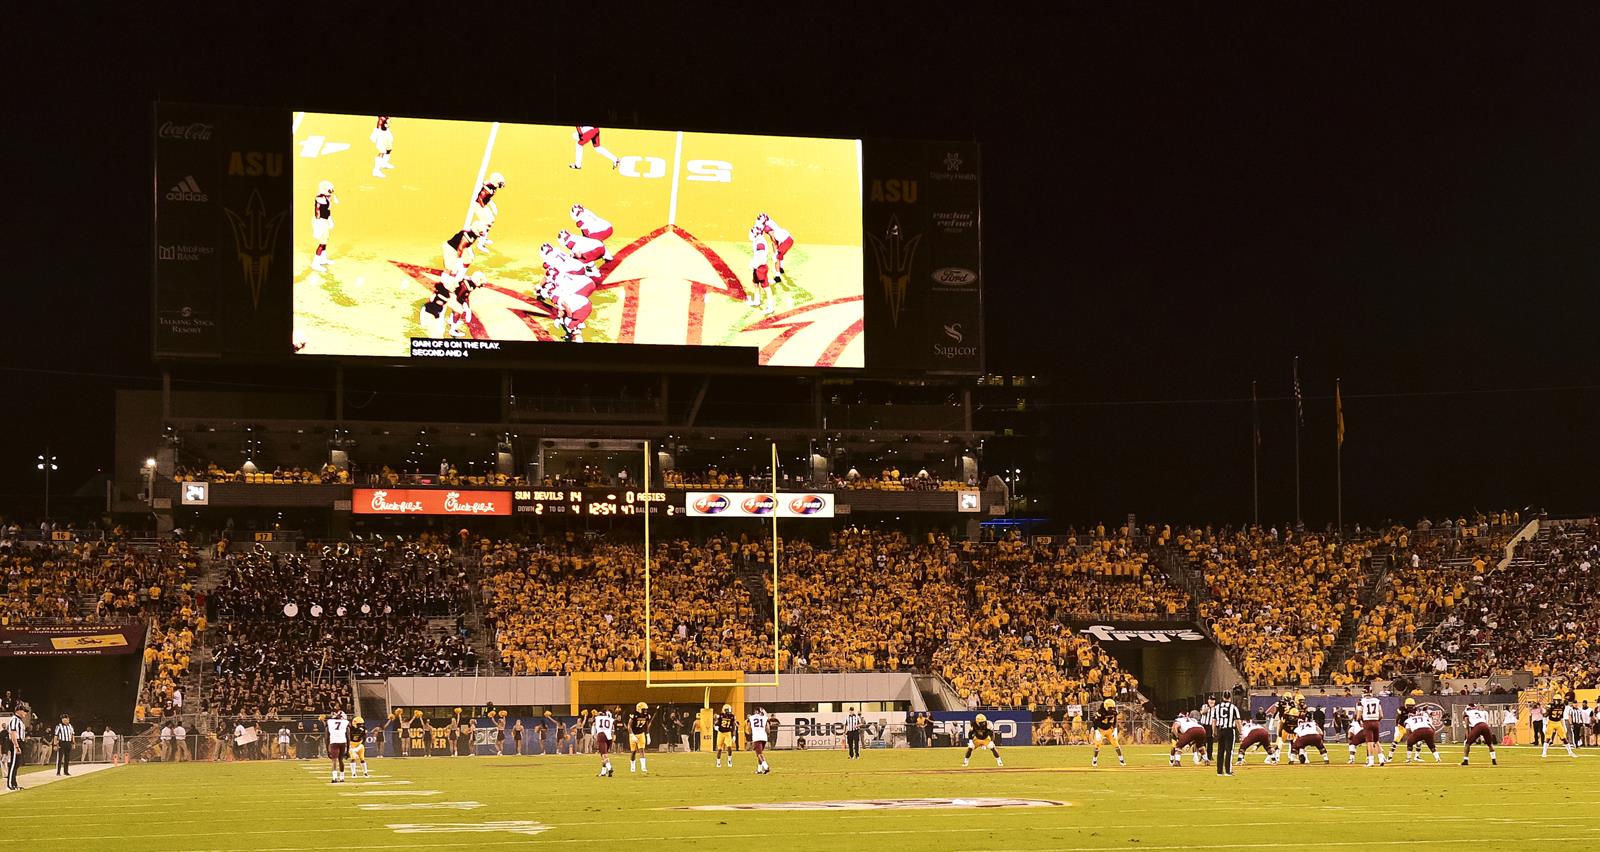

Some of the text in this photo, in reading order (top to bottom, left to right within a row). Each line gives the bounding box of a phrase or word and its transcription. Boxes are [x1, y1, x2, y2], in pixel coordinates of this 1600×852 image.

[159, 121, 214, 140] Coca-Cola
[228, 151, 283, 176] ASU
[166, 192, 209, 202] adidas
[871, 179, 918, 203] ASU
[940, 270, 969, 282] Ford
[412, 340, 431, 348] GAIN
[432, 340, 443, 348] OF
[450, 341, 462, 349] ON
[463, 341, 479, 349] THE
[480, 342, 500, 350] PLAY.
[933, 343, 977, 359] Sagicor
[412, 348, 444, 356] SECOND
[445, 349, 461, 357] AND
[515, 491, 531, 500] SUN
[534, 491, 564, 501] DEVILS
[570, 491, 582, 502] 14
[626, 491, 634, 503] 0
[535, 503, 543, 515] 2
[572, 505, 580, 514] 4
[589, 503, 616, 515] 12:54
[621, 505, 634, 515] 47
[666, 504, 675, 516] 2
[1080, 625, 1205, 643] fry's
[1220, 707, 1228, 718] C
[1366, 703, 1377, 715] 17
[334, 722, 341, 731] 7
[599, 719, 610, 729] 10
[753, 718, 764, 728] 21
[794, 717, 887, 741] Blueky
